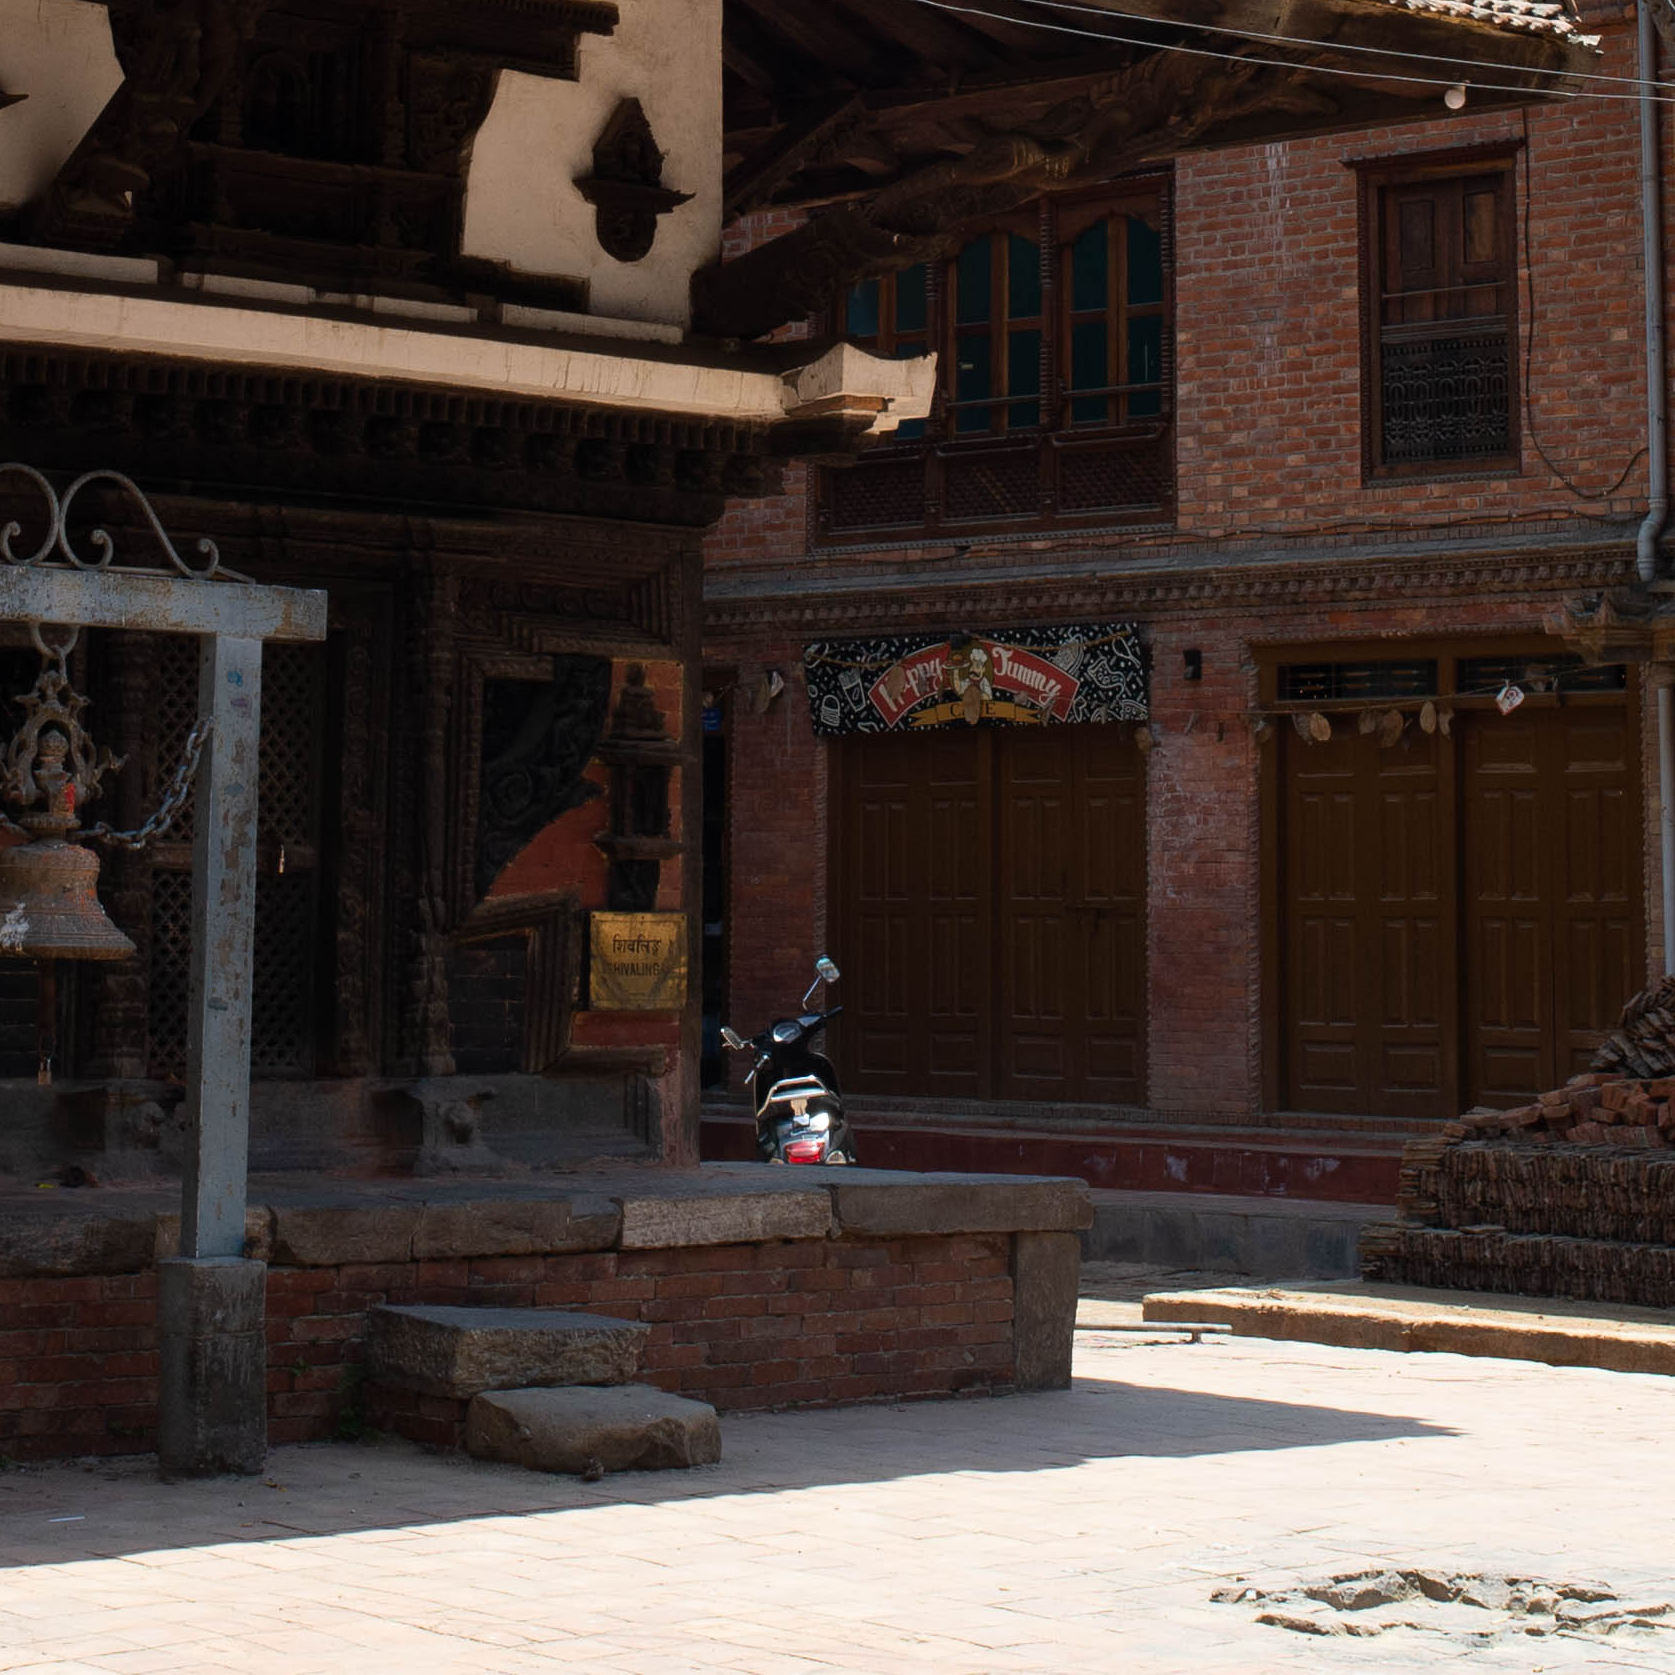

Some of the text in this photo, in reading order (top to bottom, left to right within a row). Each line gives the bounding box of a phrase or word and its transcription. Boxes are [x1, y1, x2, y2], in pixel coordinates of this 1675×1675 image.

[878, 646, 1063, 713] Hppy Tummy
[949, 701, 997, 718] CE
[605, 962, 669, 977] HIVALING
